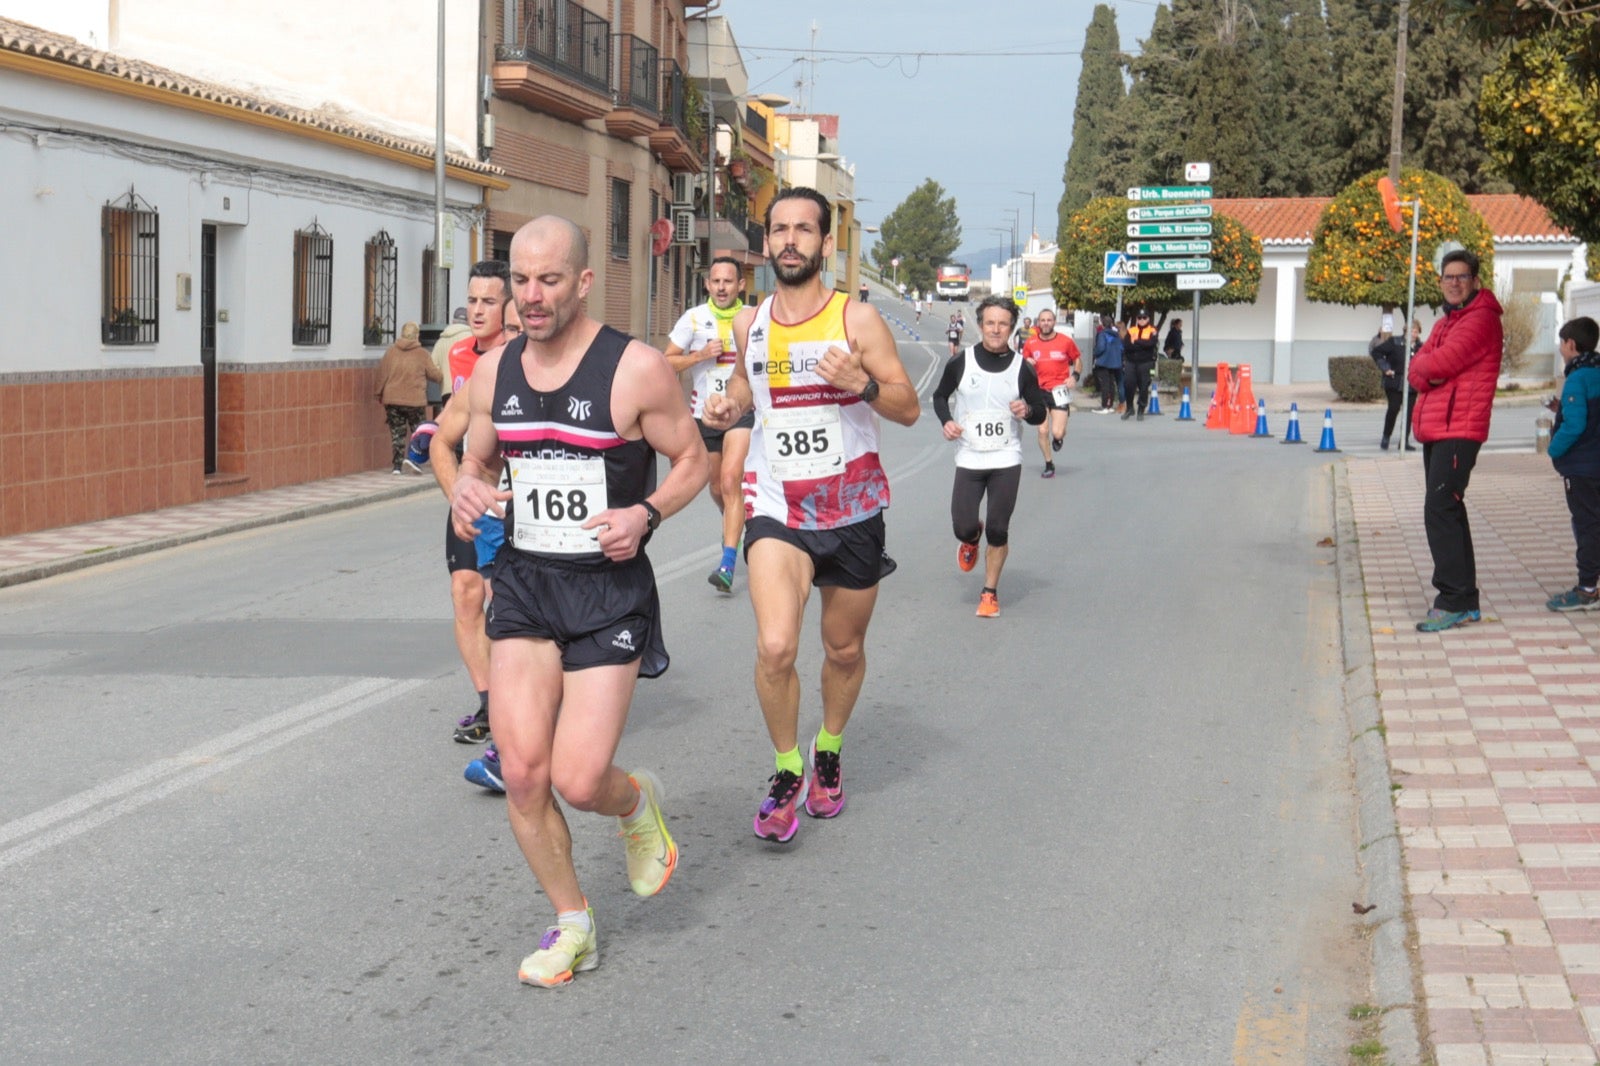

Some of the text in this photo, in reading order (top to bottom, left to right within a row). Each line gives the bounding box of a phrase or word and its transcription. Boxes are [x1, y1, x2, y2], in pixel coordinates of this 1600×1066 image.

[1142, 189, 1210, 198] Urb. Buenavista
[1154, 209, 1174, 218] Parque
[1175, 208, 1184, 216] del
[1175, 225, 1182, 233] El
[1166, 243, 1187, 252] Monte
[1188, 243, 1208, 251] Elvira
[1148, 260, 1208, 270] Urb. Cortijo Pretel
[975, 422, 1004, 437] 186
[776, 428, 829, 457] 385
[526, 488, 589, 522] 168
